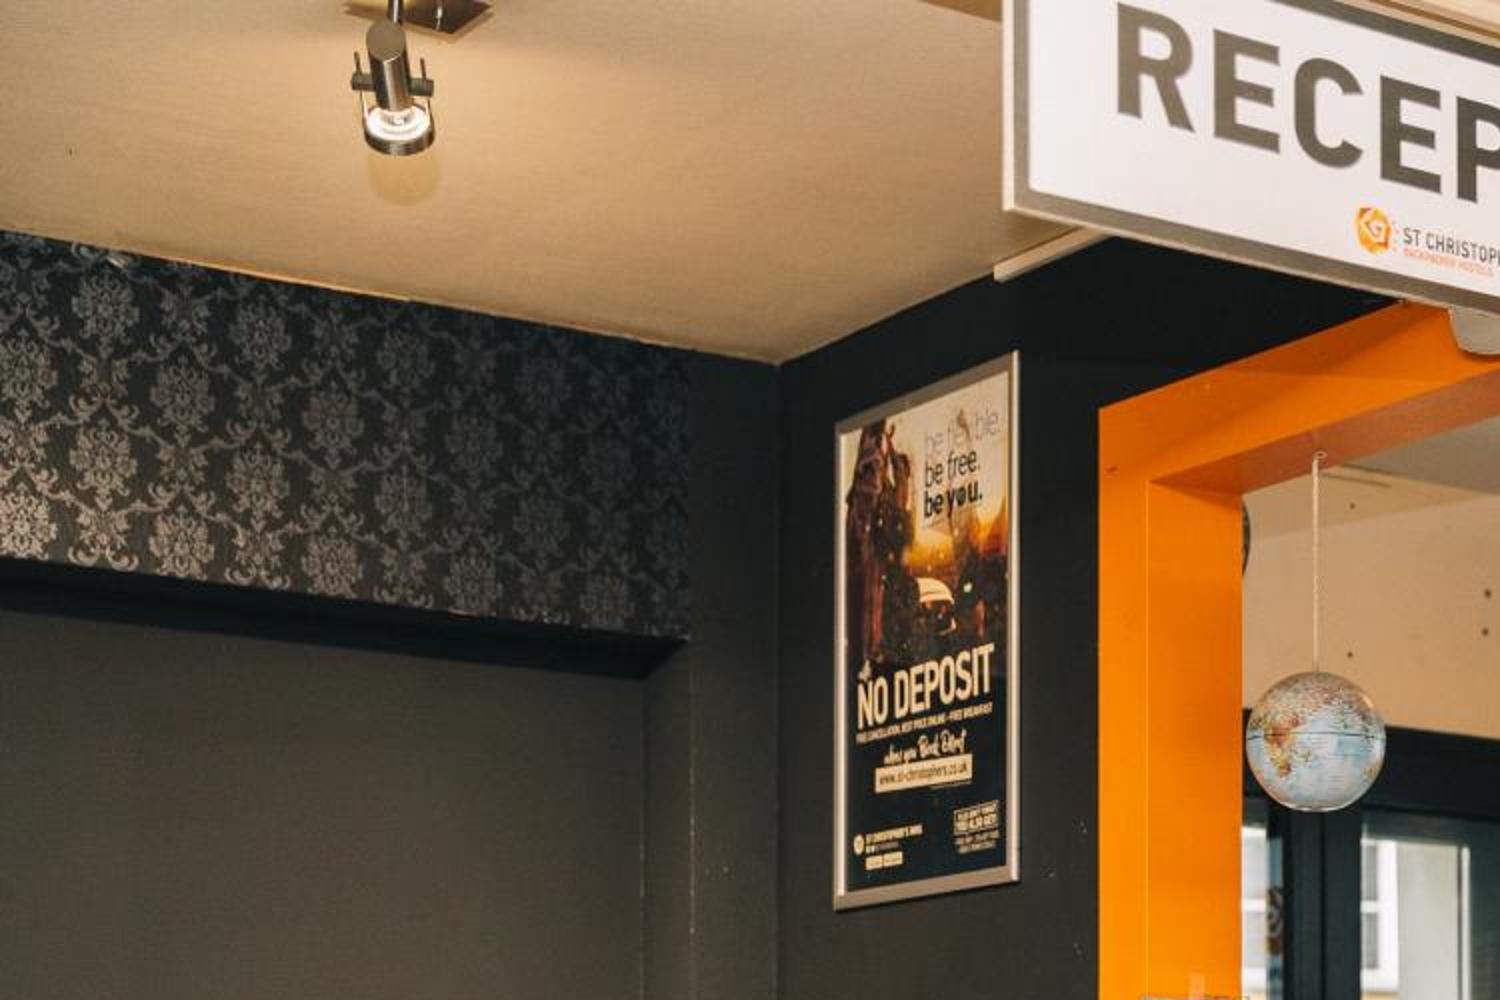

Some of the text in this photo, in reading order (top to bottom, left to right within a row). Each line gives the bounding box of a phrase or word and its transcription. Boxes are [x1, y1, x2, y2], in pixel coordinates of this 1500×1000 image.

[1403, 227, 1424, 247] ST
[925, 449, 981, 488] be free.
[923, 480, 983, 519] be you.
[857, 643, 995, 730] NO DEPOSIT
